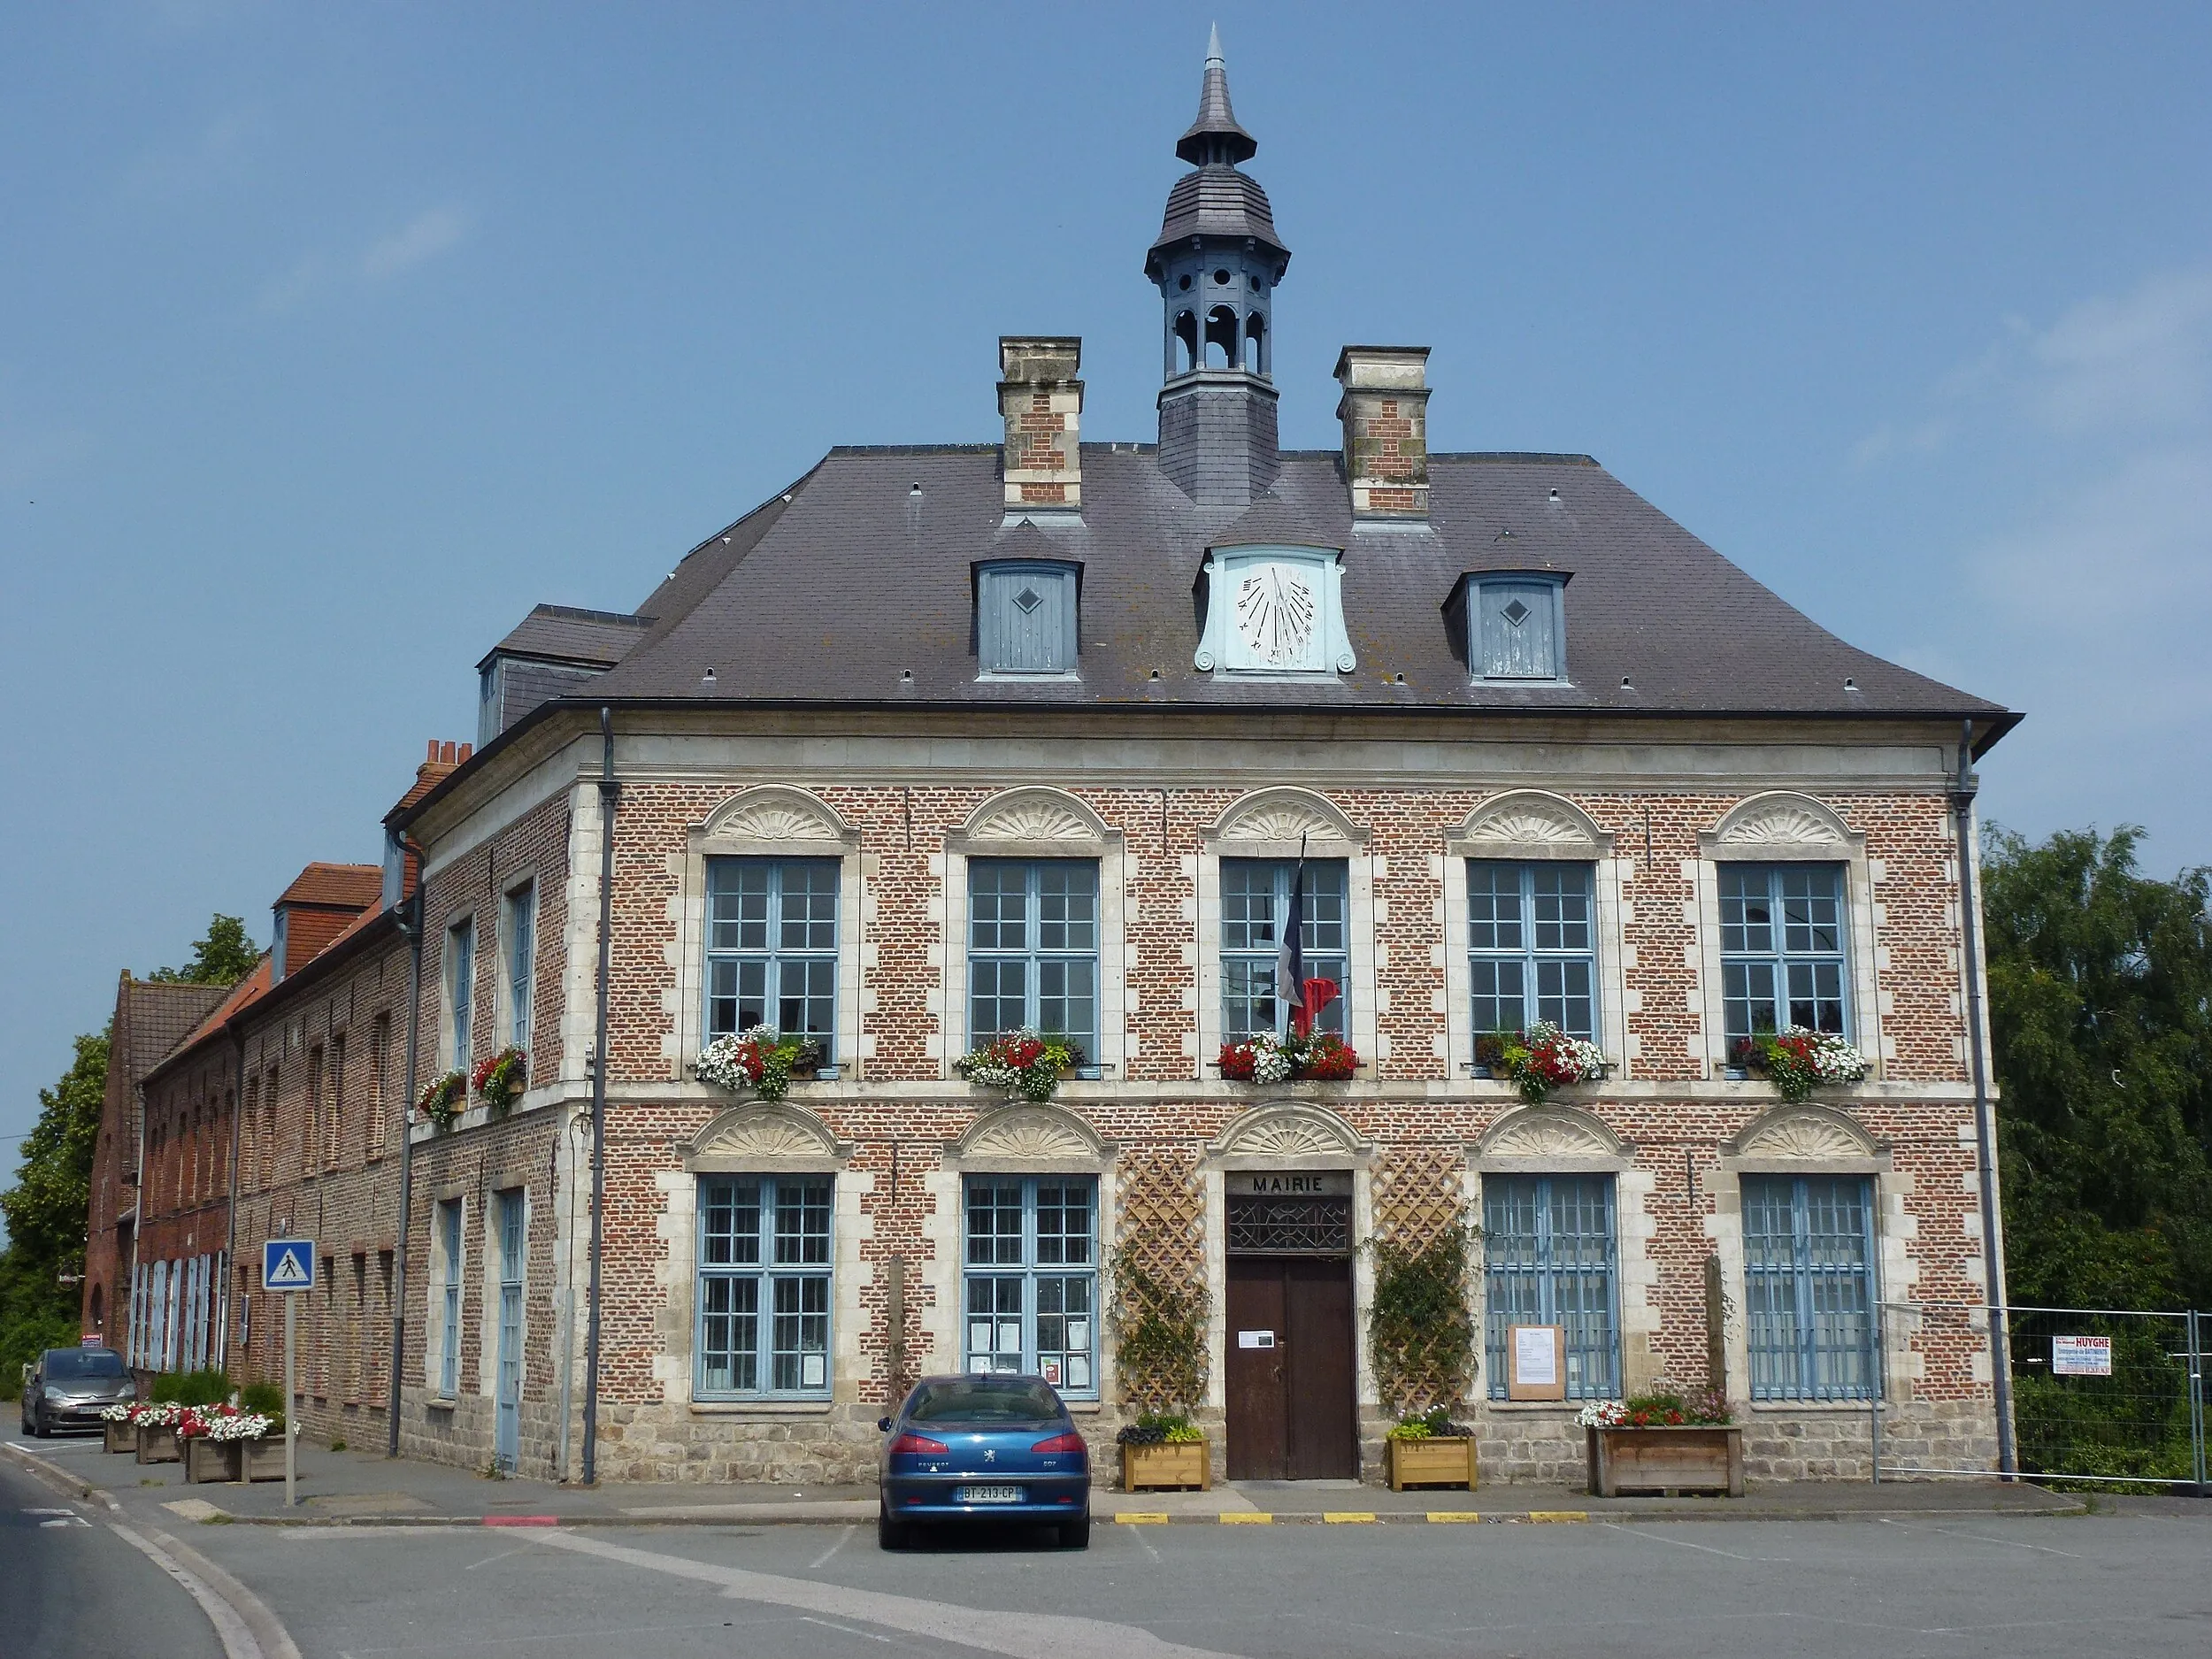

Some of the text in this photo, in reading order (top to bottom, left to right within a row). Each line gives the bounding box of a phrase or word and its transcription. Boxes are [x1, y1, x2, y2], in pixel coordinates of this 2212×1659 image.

[1252, 1177, 1323, 1192] MAIRIE
[2076, 1338, 2109, 1347] HUYGHE
[964, 1487, 1014, 1499] BT-213-CP
